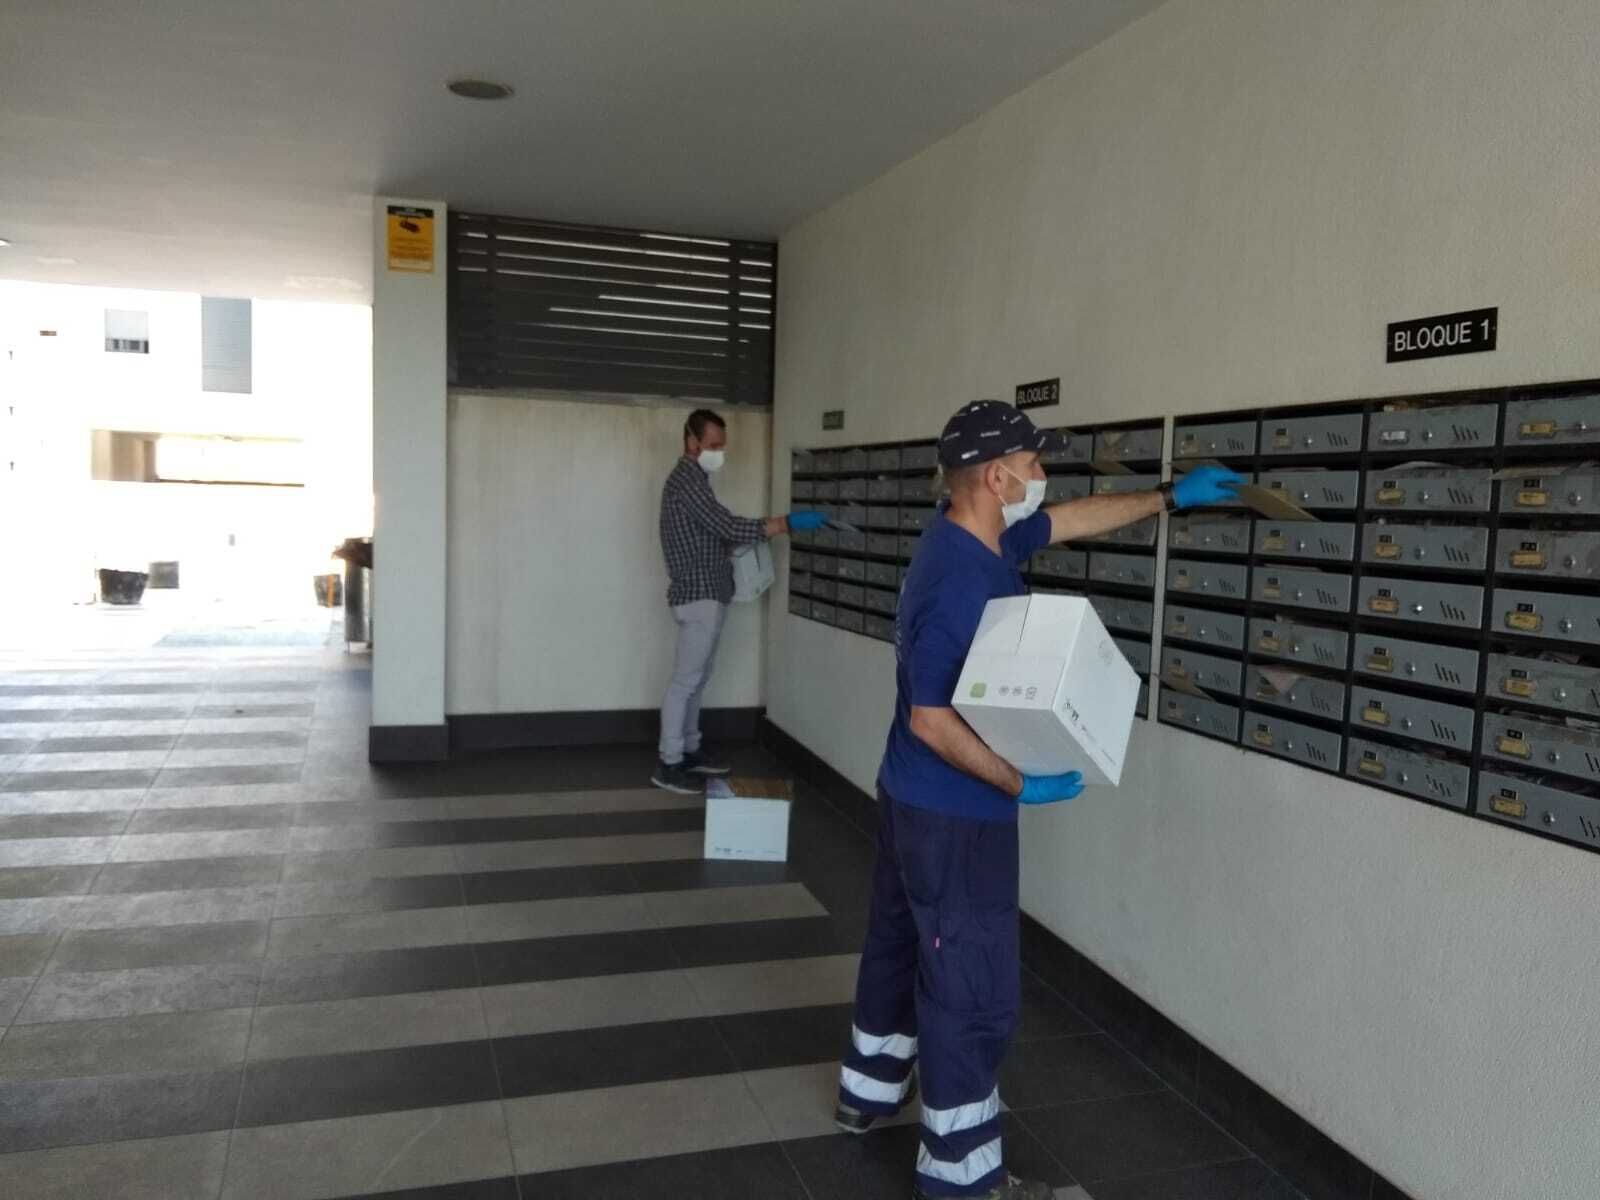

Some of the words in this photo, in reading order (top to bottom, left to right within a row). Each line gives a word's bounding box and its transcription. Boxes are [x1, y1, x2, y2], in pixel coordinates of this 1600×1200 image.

[1394, 321, 1473, 353] BLOQUE
[1480, 318, 1490, 341] 1
[1017, 385, 1049, 404] BLOQUE
[1050, 383, 1058, 400] 2
